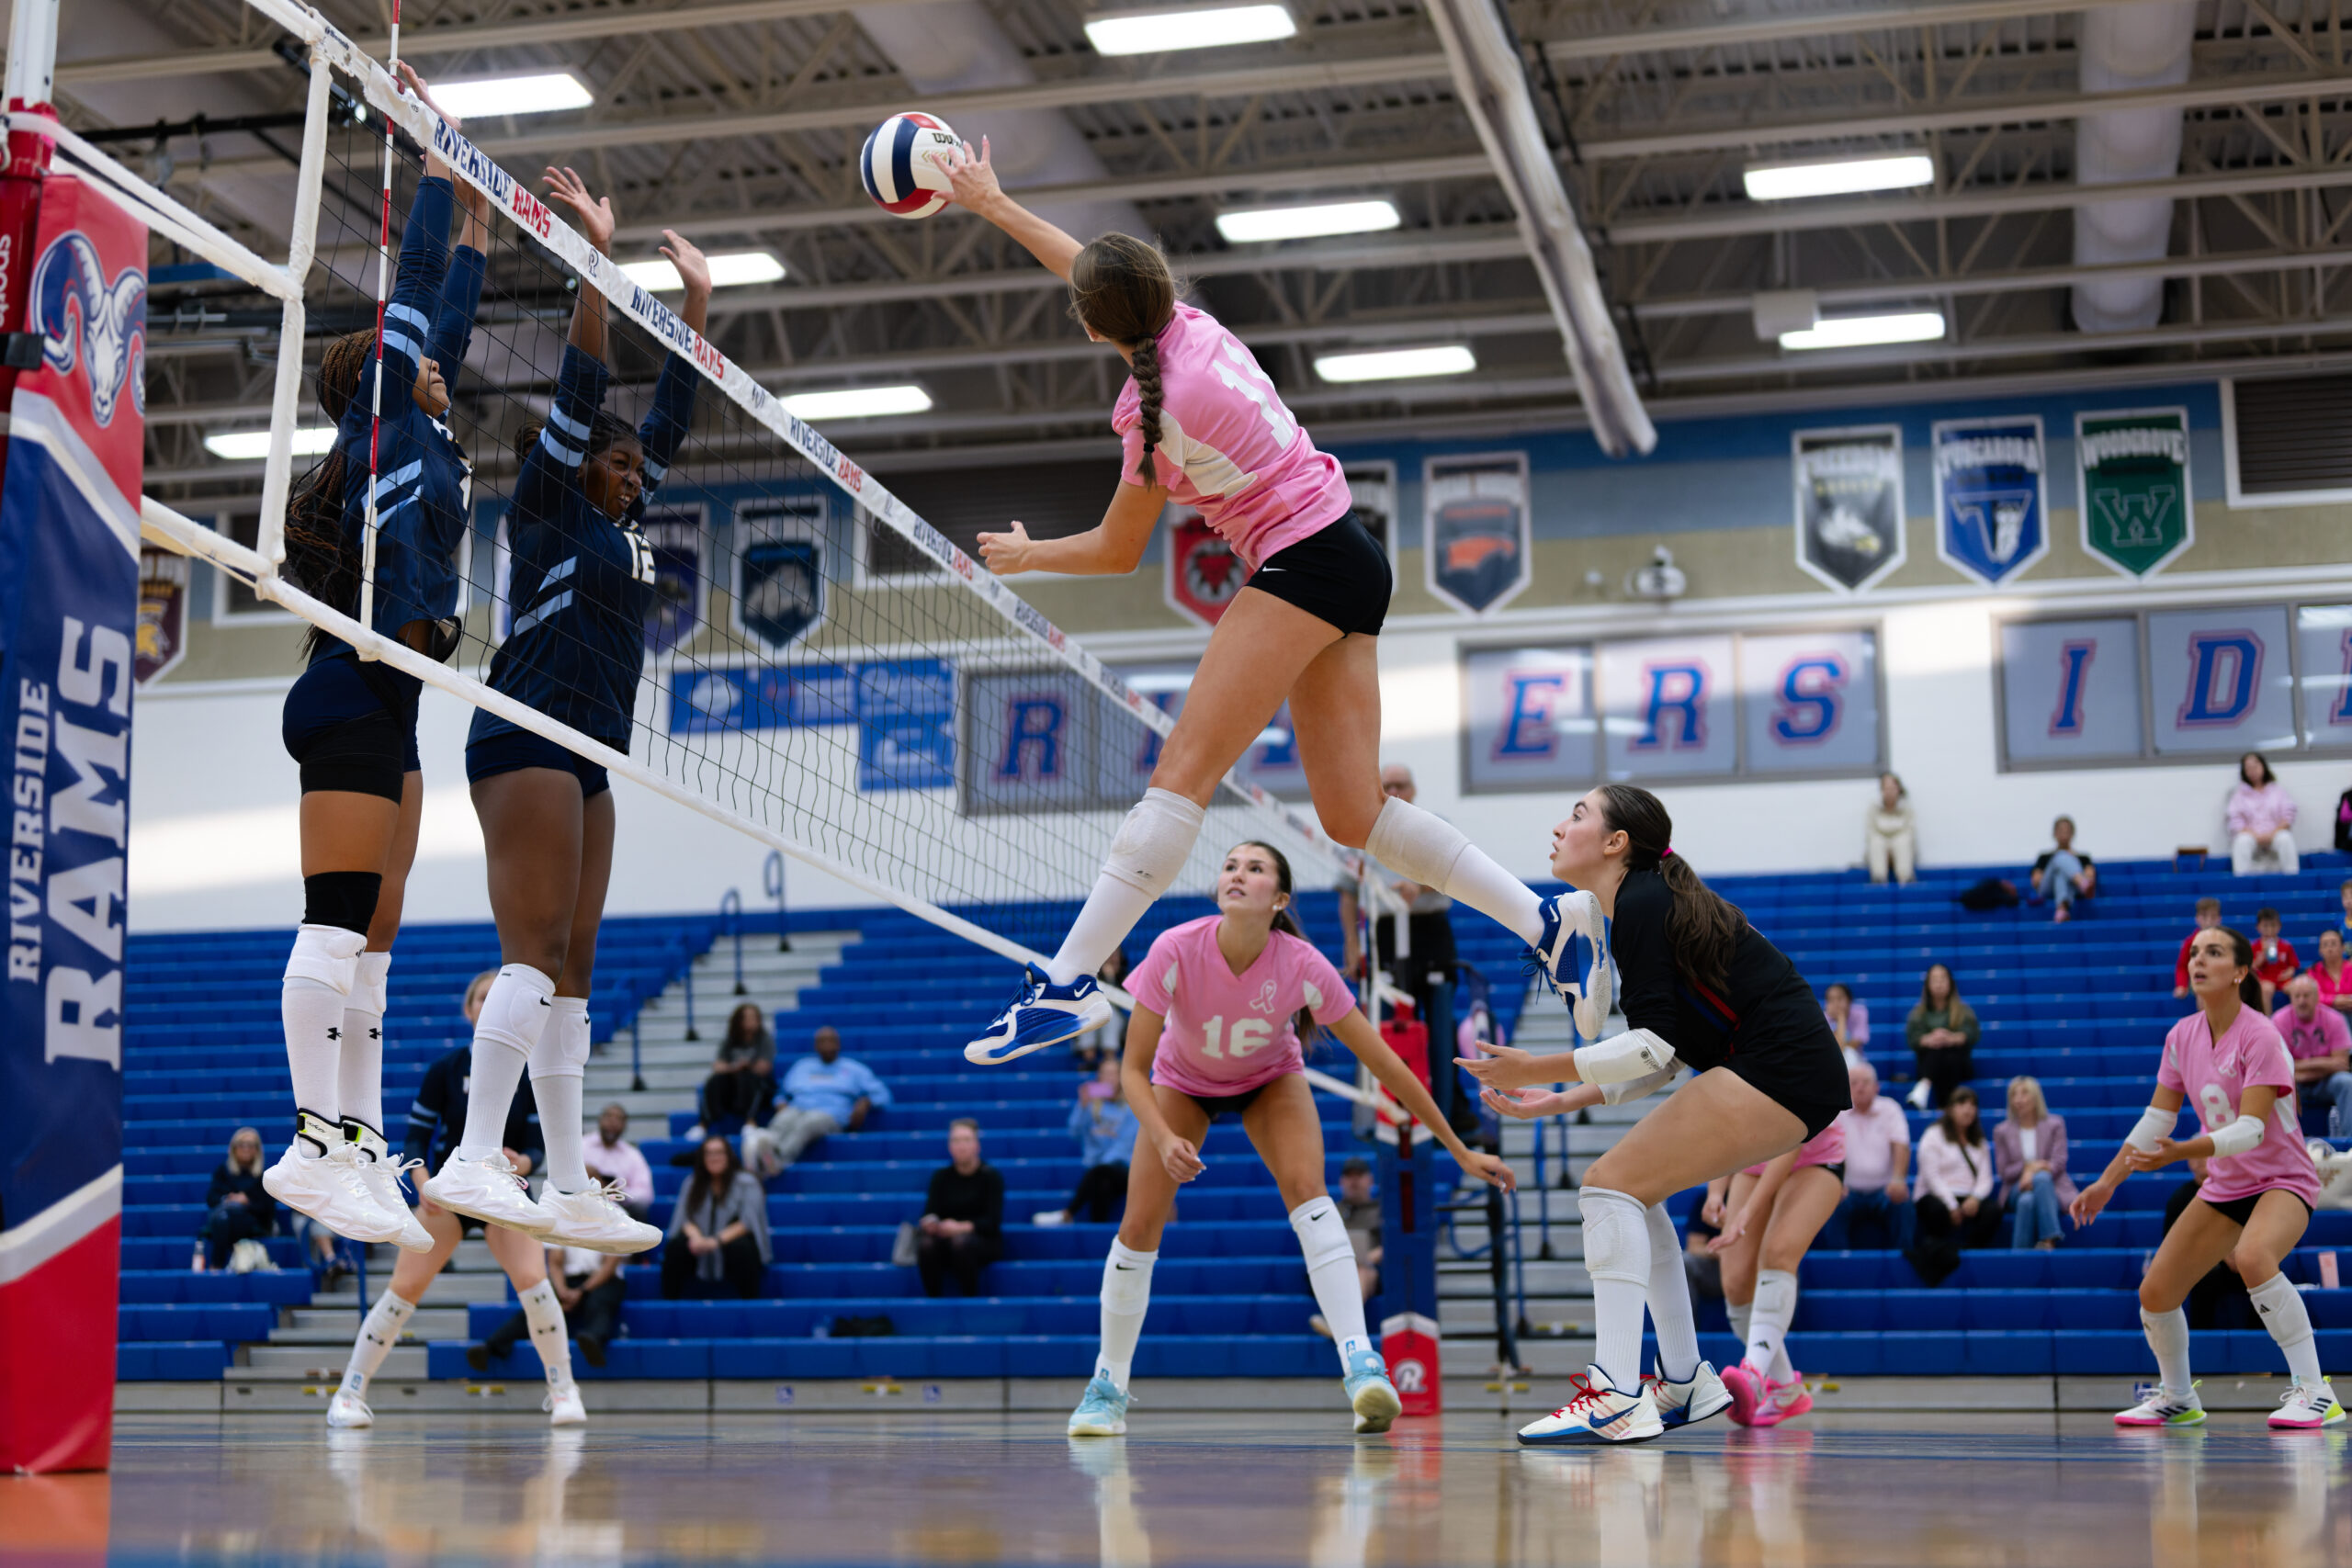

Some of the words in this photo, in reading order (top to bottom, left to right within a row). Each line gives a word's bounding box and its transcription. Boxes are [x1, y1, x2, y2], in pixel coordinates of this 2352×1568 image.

[434, 117, 511, 205] RIVERSIDE
[512, 184, 551, 239] RAMS
[630, 285, 692, 354] RIVERSIDE
[694, 334, 724, 379] RAMS
[790, 416, 838, 473] RIVERSIDE
[838, 455, 863, 492] RAMS
[2094, 484, 2176, 547] W
[8, 678, 49, 984] RIVERSIDE
[45, 615, 131, 1072] RAMS
[1201, 1015, 1273, 1059] 16
[2200, 1083, 2236, 1130] 8
